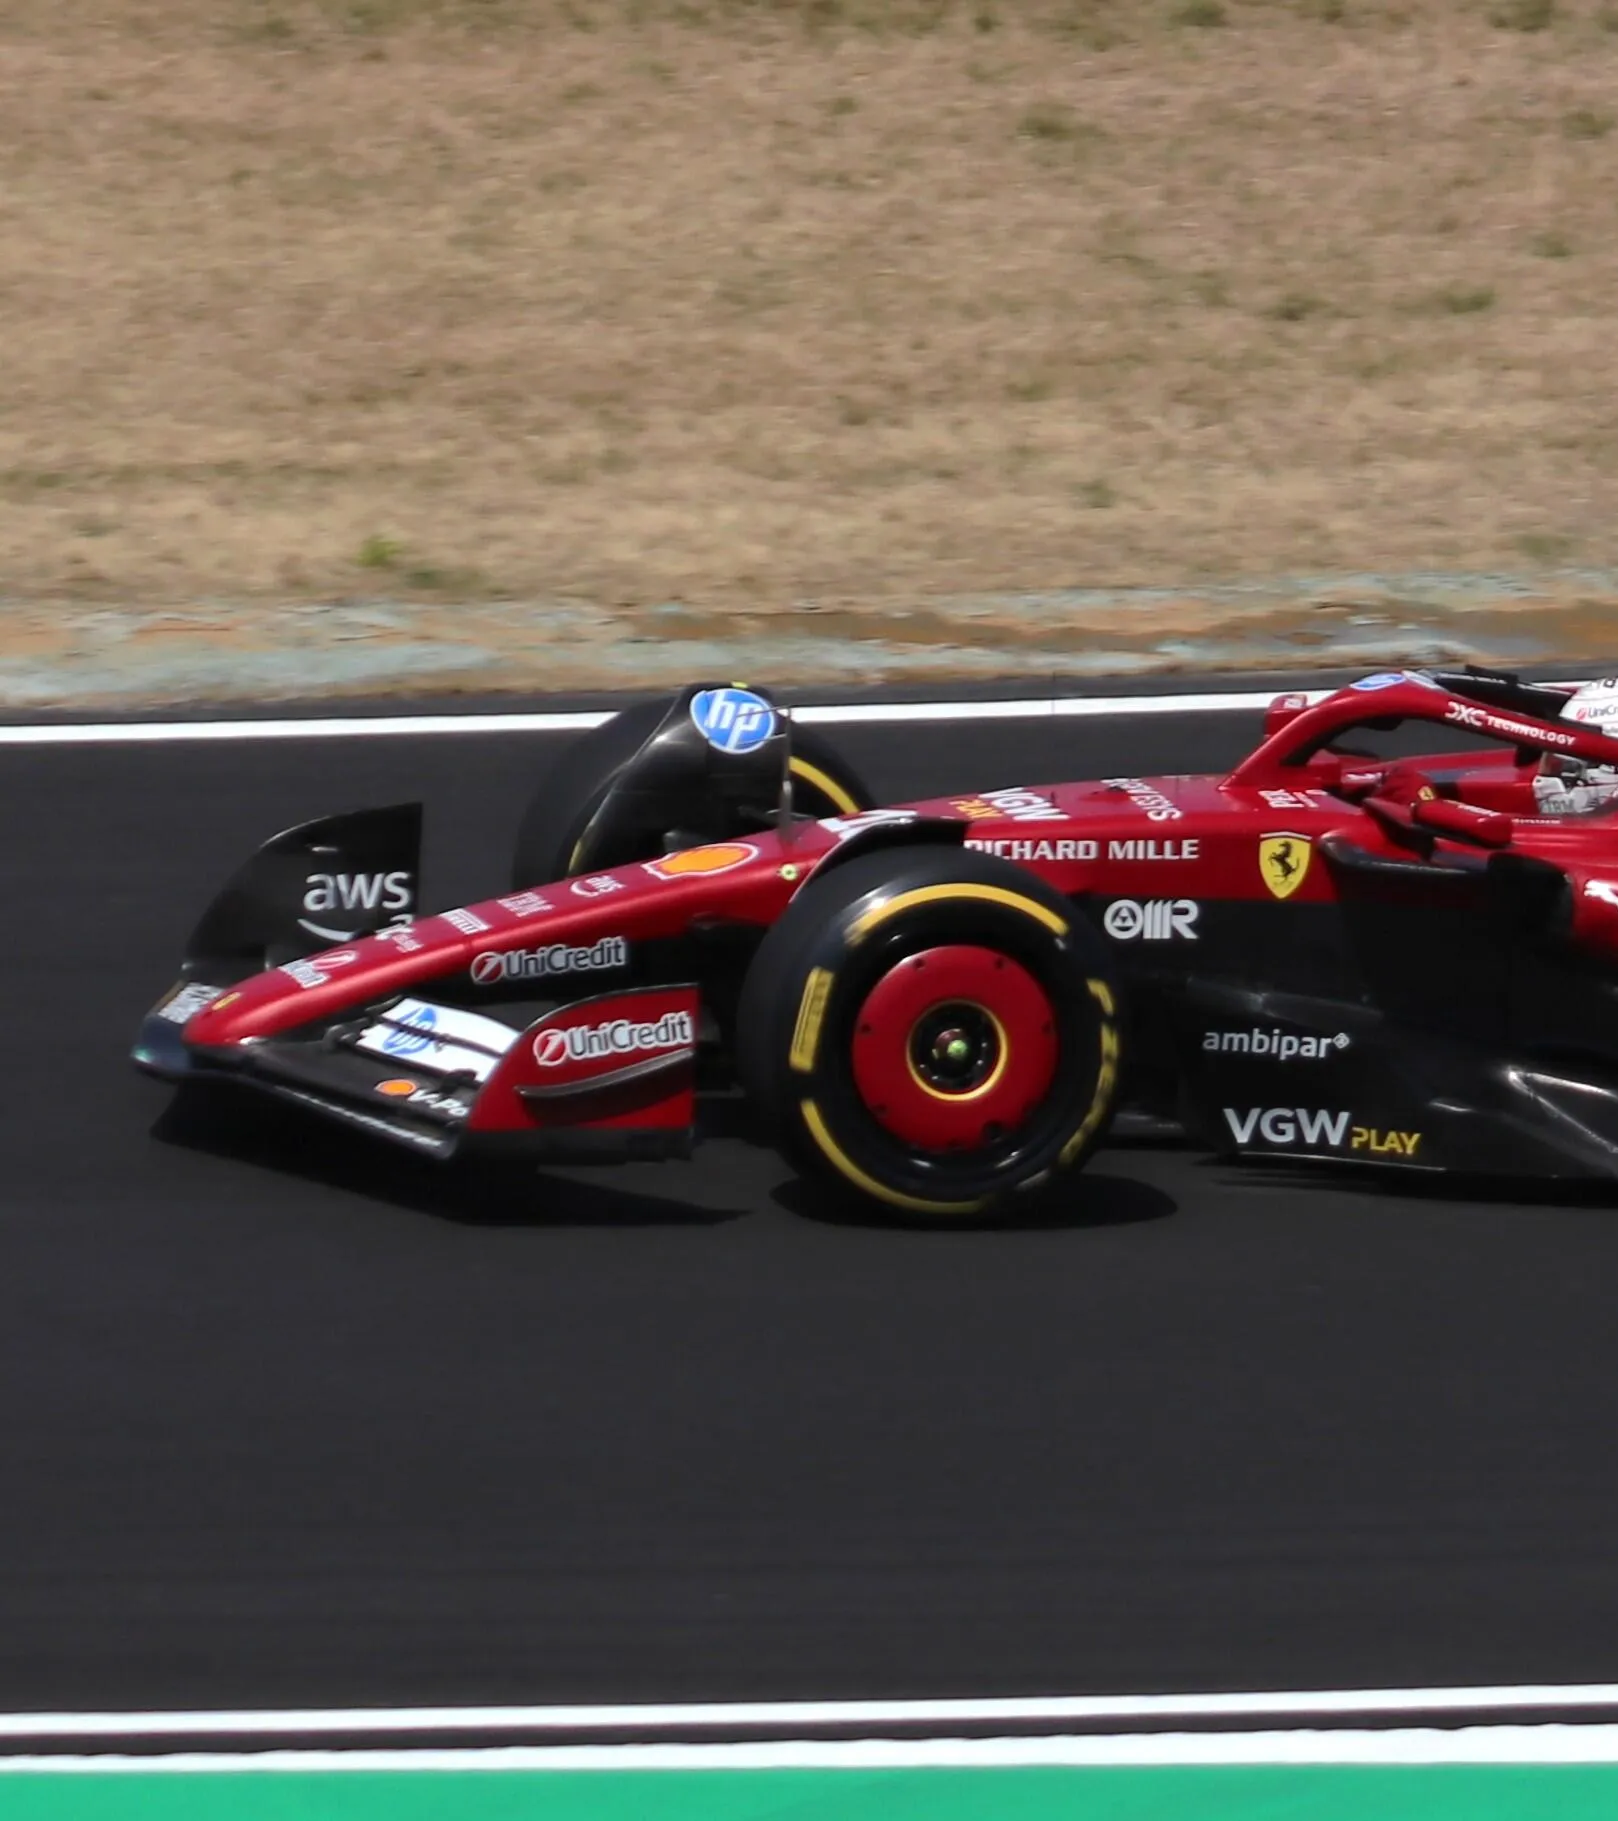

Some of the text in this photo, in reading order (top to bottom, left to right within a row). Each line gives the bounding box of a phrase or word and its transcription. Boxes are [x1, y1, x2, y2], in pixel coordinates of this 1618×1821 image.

[704, 688, 766, 752] hp
[1445, 701, 1577, 746] DXC TECHNOLOGY
[978, 787, 1071, 820] VGW
[1108, 839, 1199, 860] MILLE
[303, 871, 411, 911] aws
[505, 936, 625, 977] UniCredit
[569, 1011, 692, 1062] UniCredit
[1202, 1027, 1332, 1060] ambipar
[407, 1089, 469, 1118] V-Po
[1223, 1107, 1420, 1154] VGW PLAY
